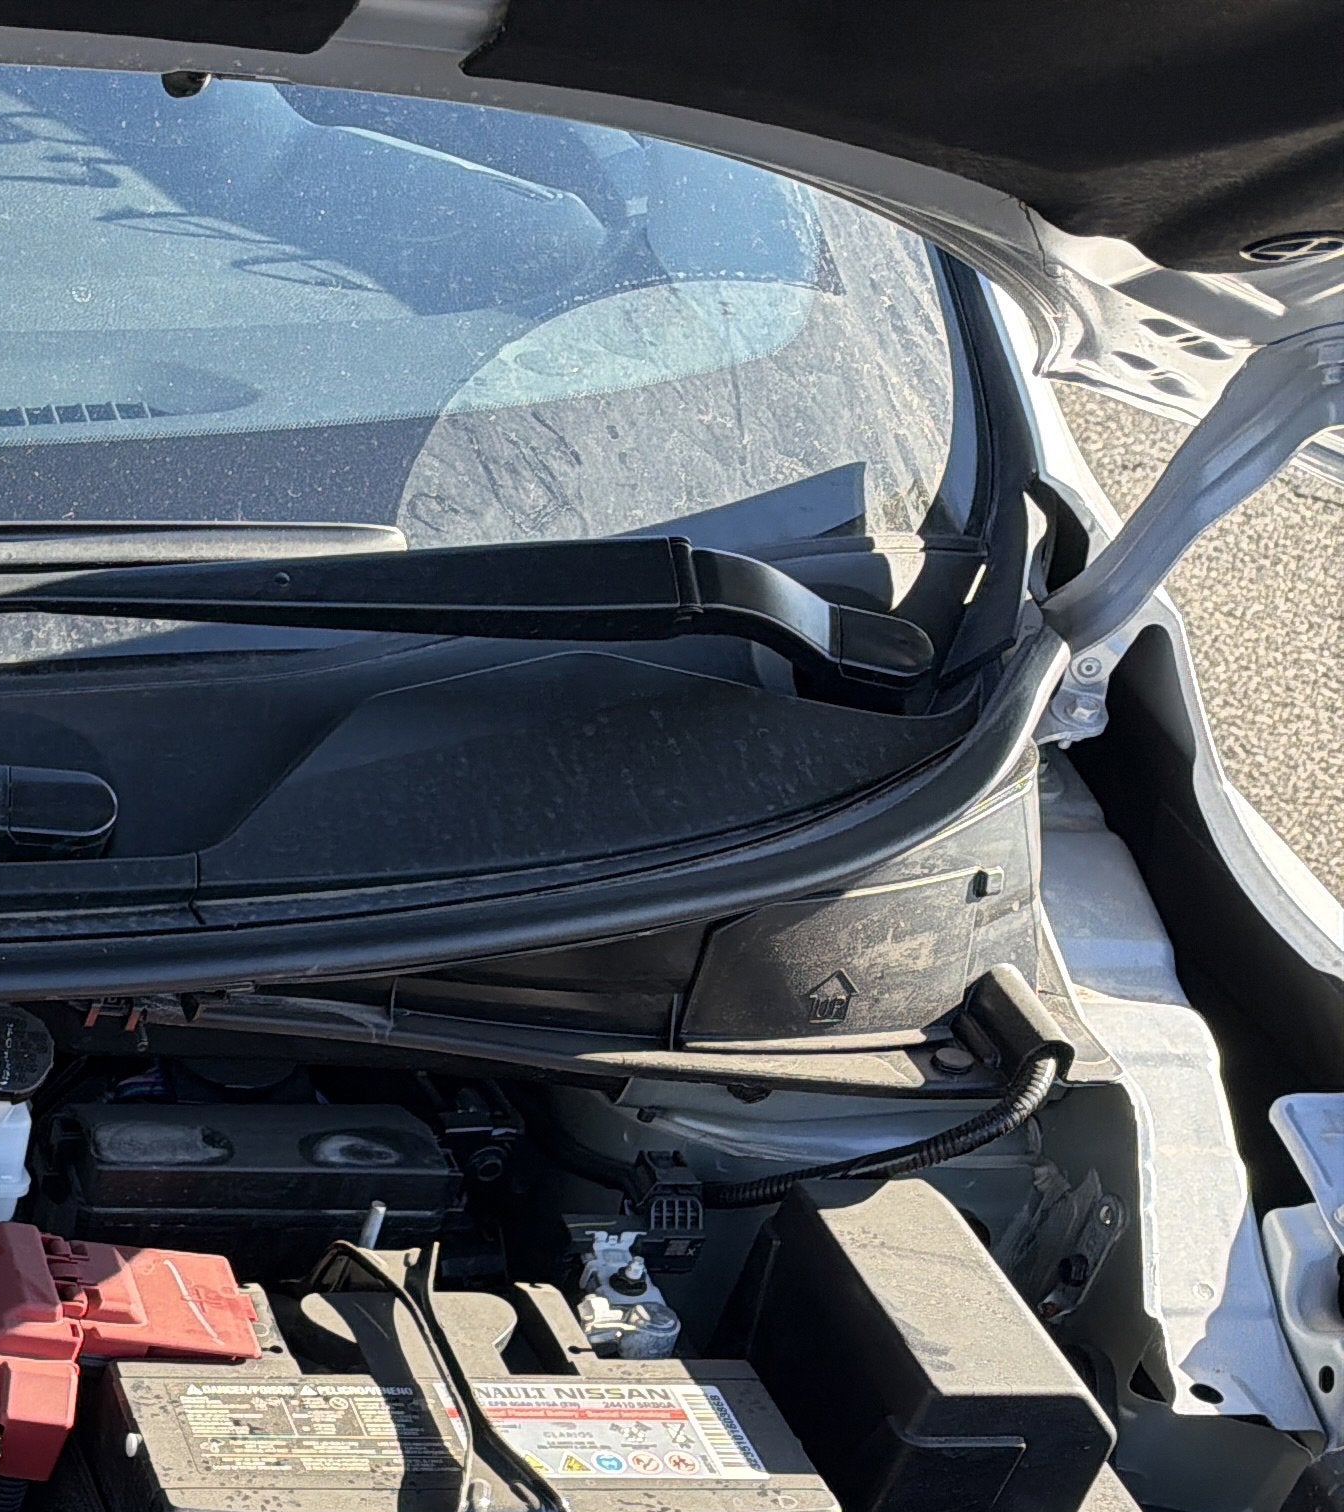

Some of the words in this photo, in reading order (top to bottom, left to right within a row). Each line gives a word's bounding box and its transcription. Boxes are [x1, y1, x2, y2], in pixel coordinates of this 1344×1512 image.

[474, 1387, 546, 1399] NAULT
[553, 1387, 671, 1400] NISSAN
[543, 1431, 594, 1439] CLARIOS
